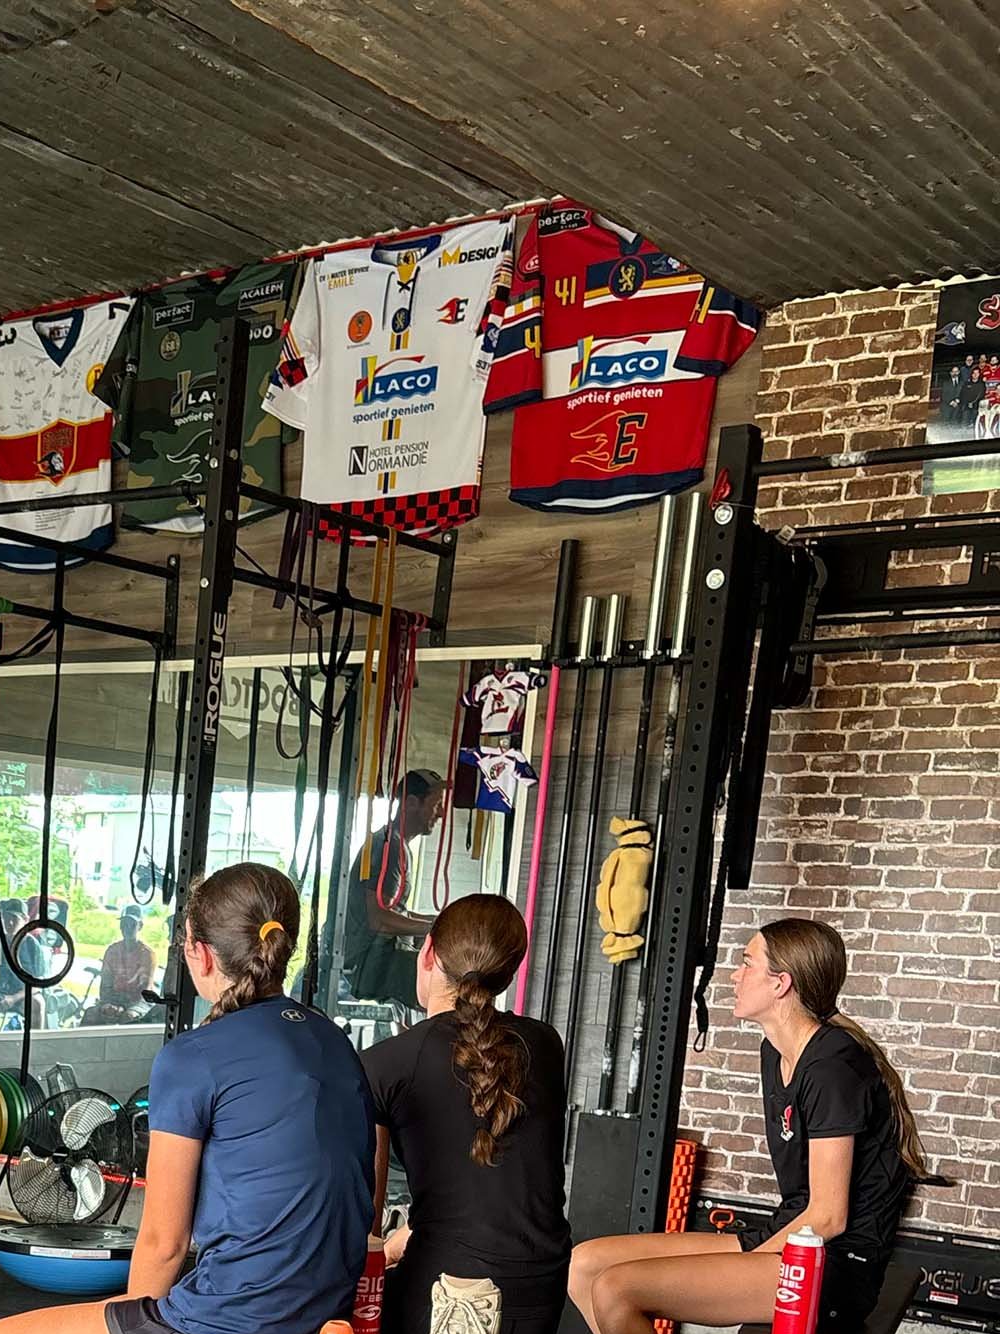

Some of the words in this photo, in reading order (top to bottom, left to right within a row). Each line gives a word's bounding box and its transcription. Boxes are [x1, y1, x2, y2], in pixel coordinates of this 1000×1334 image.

[555, 276, 577, 306] 41
[590, 357, 659, 377] LACO
[374, 374, 431, 394] LACO
[567, 391, 611, 410] sportief
[613, 387, 663, 405] genieten
[204, 612, 227, 736] ROGUE
